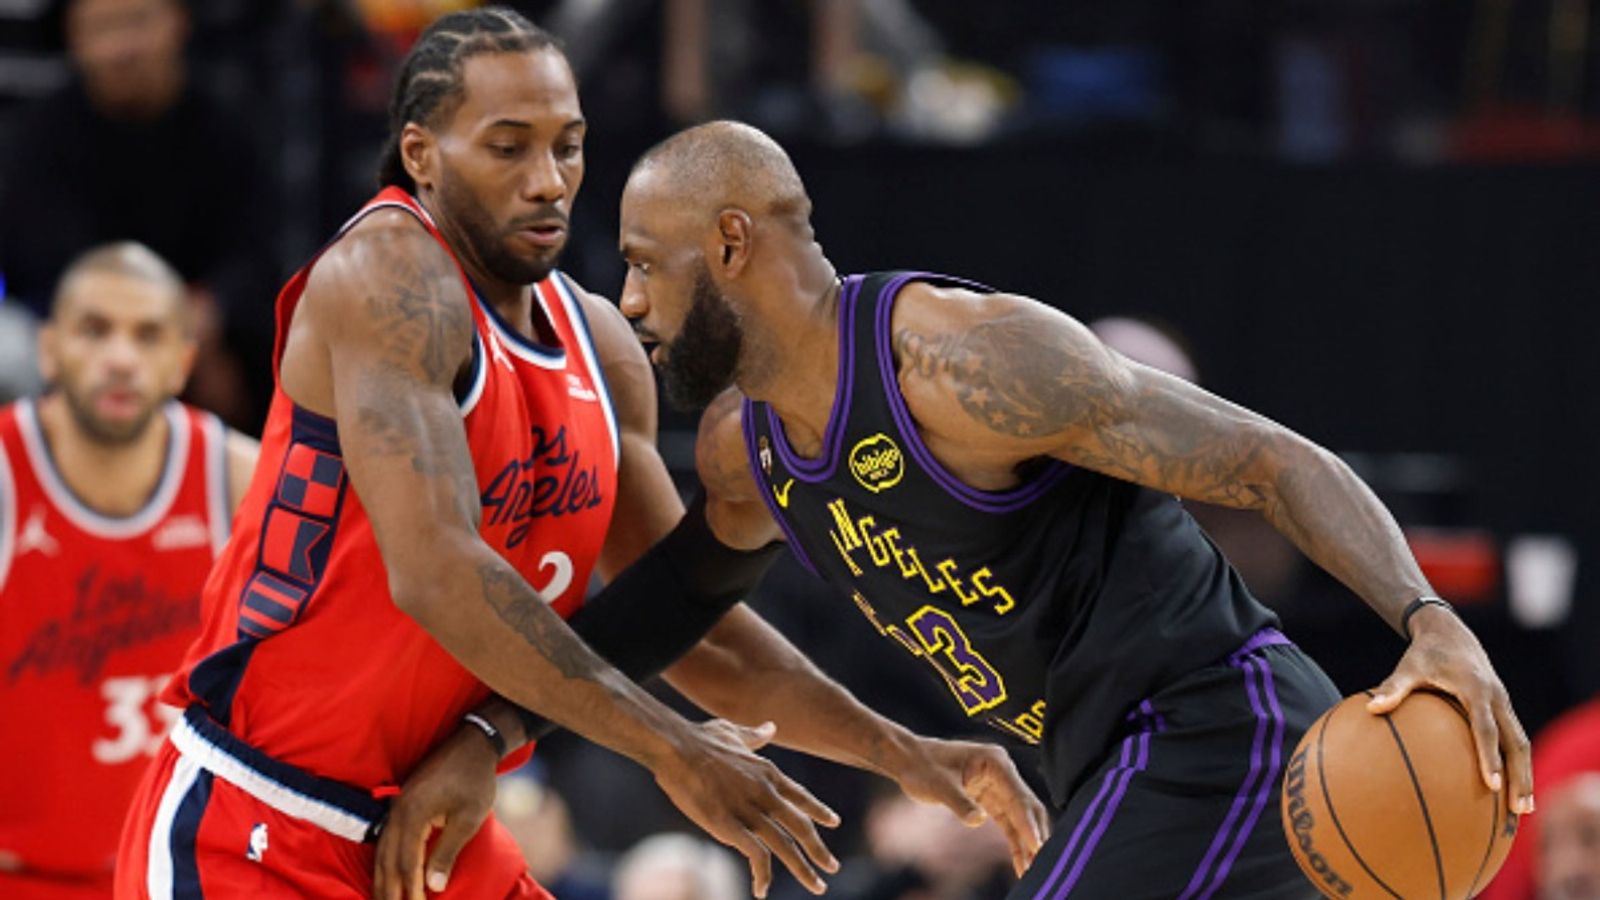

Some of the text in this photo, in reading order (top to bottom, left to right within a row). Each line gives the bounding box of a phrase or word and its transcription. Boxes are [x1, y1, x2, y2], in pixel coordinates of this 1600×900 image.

[479, 450, 602, 549] Angeles
[538, 549, 573, 605] 2
[826, 497, 1016, 616] NGELES
